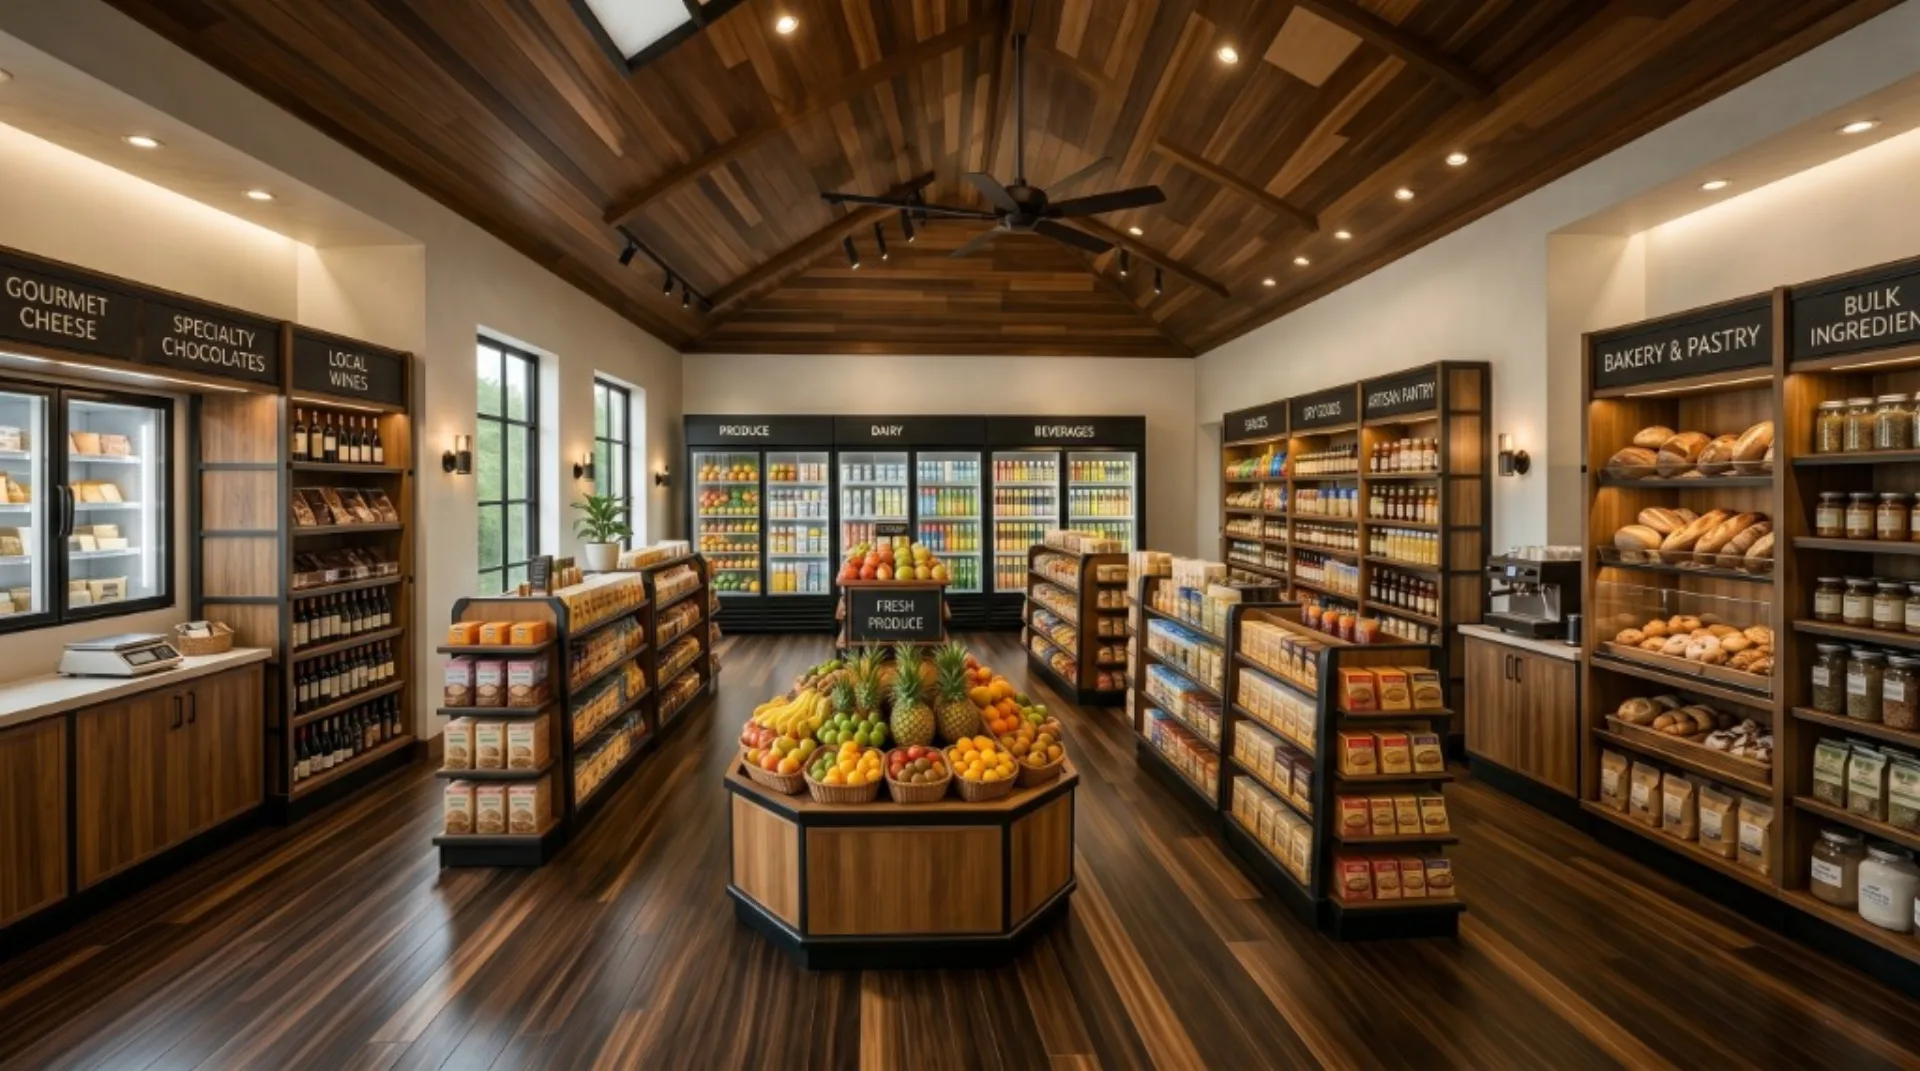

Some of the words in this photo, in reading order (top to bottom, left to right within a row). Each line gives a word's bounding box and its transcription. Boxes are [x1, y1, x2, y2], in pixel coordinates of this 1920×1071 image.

[6, 276, 108, 317] GOURMET
[1844, 286, 1900, 317] BULK
[19, 307, 97, 340] CHEESE
[173, 314, 255, 349] SPECIALTY
[162, 336, 265, 373] CHOCOLATES
[1604, 342, 1666, 373] BAKERY
[1670, 339, 1683, 361] &
[1687, 323, 1761, 357] PASTRY
[328, 348, 368, 374] LOCAL
[329, 369, 368, 392] WINES
[1402, 381, 1436, 403] PANTRY
[719, 424, 770, 437] PRODUCE
[871, 424, 903, 437] DAIRY
[1034, 424, 1095, 438] BEVERAGES
[876, 599, 914, 613] FRESH
[868, 616, 924, 630] PRODUCE
